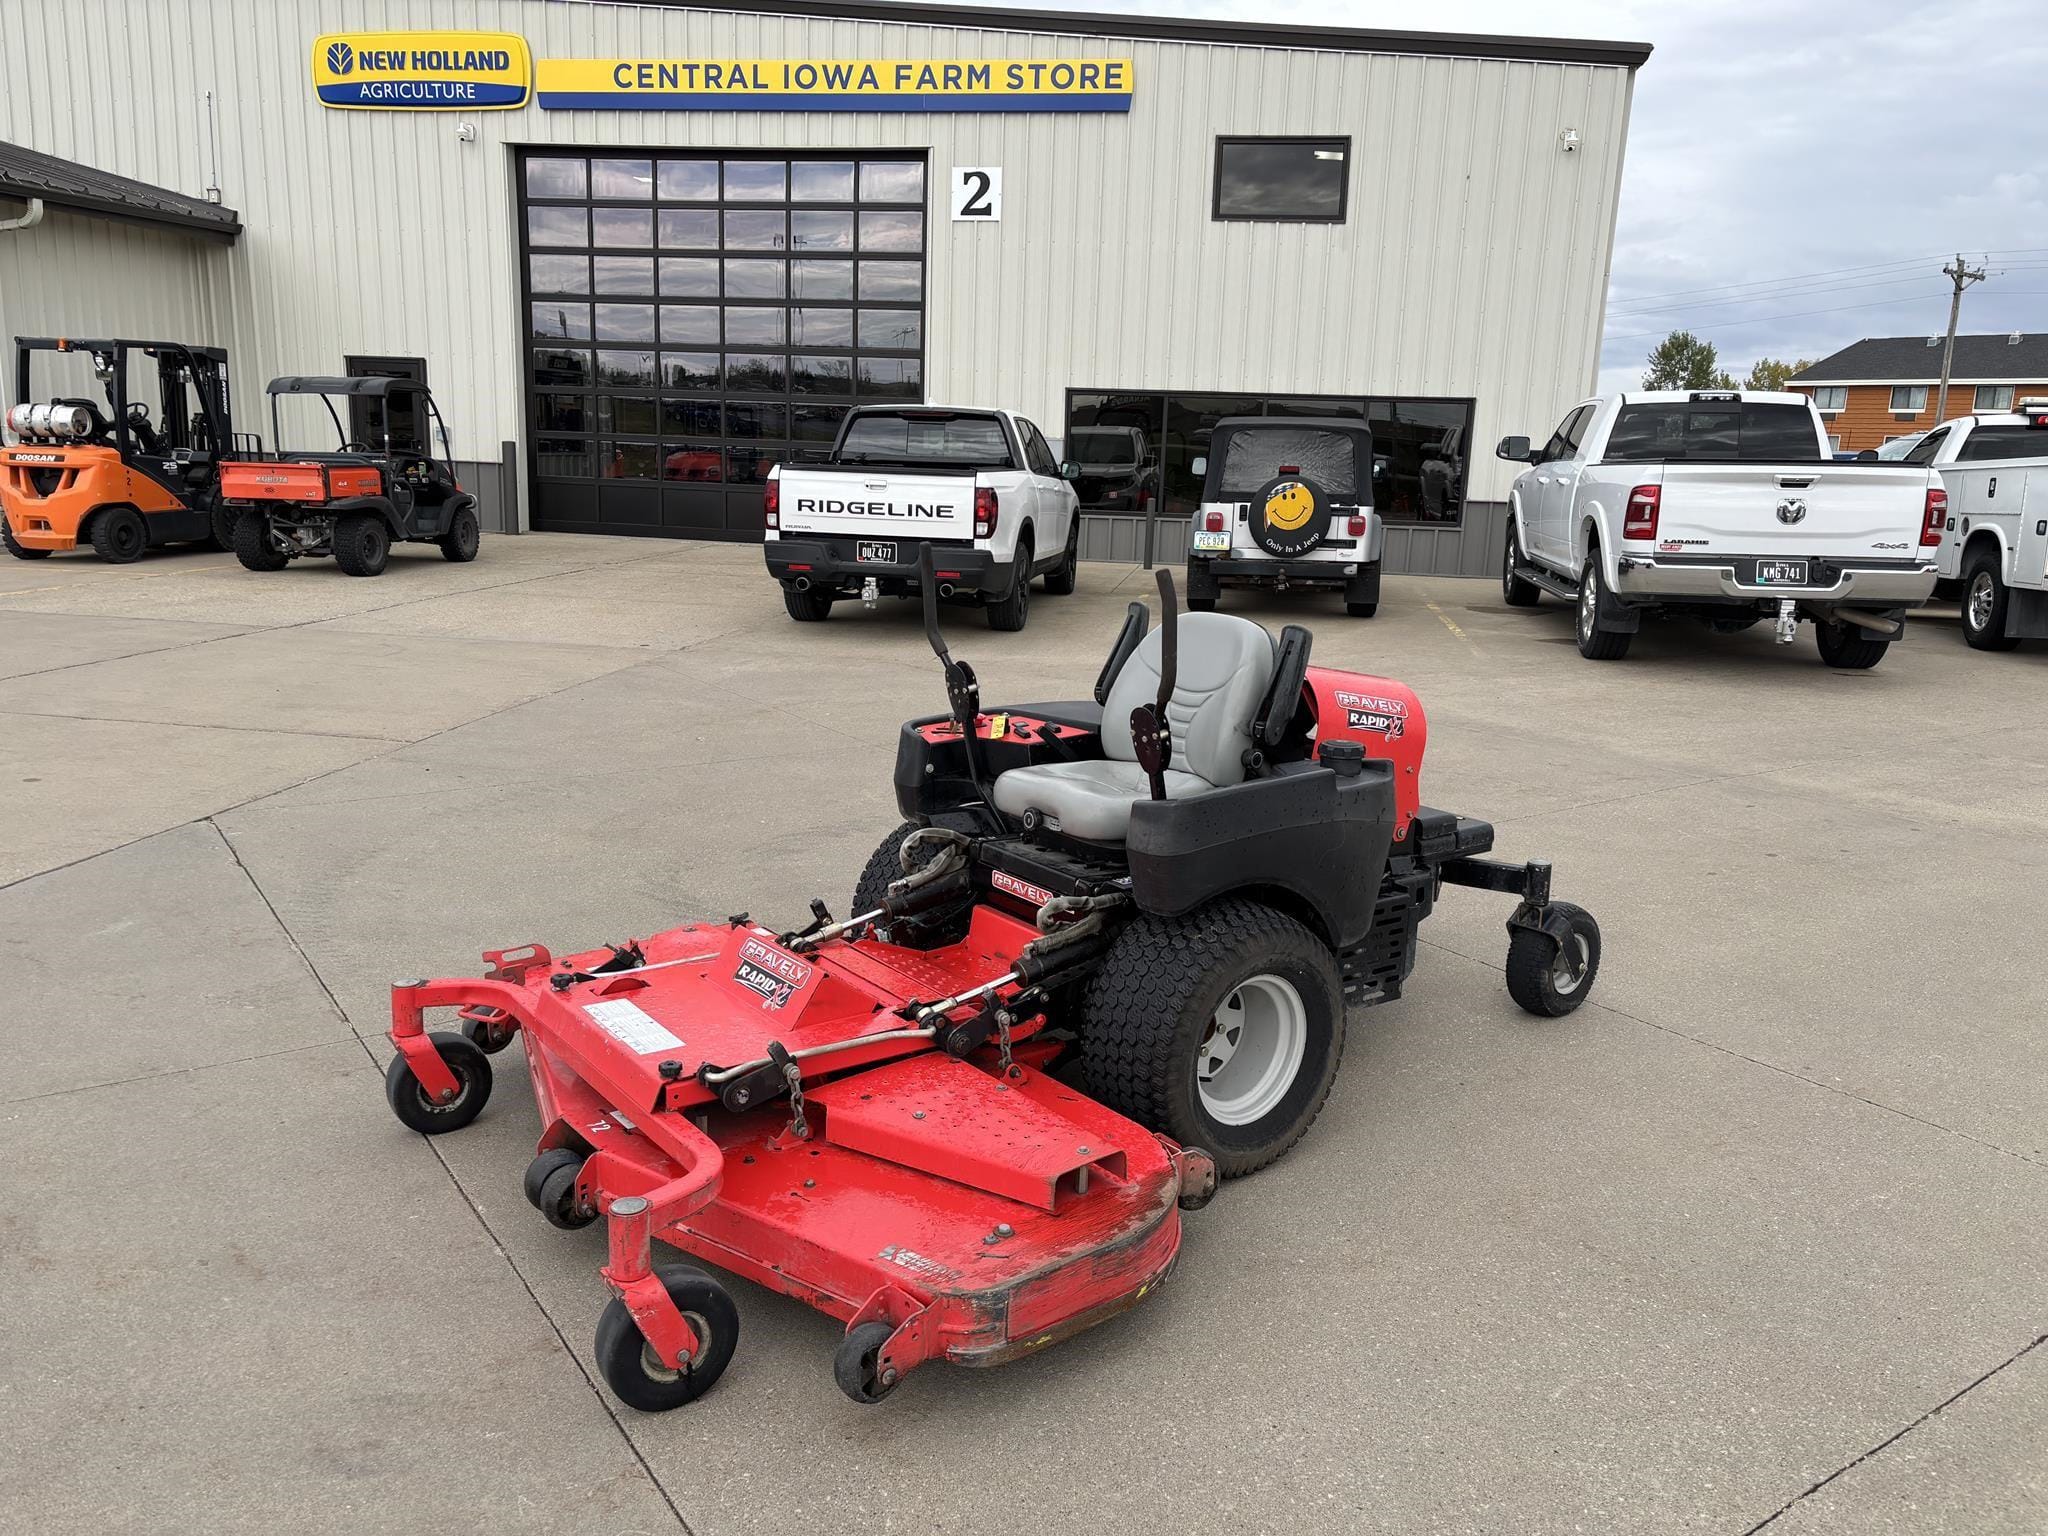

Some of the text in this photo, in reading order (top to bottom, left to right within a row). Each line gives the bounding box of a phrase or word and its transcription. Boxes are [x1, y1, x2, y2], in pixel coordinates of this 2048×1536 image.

[359, 50, 510, 71] NEW HOLLAND
[613, 63, 1123, 91] CENTRAL IOWA FARM STORE
[360, 83, 476, 99] AGRICULTURE
[960, 171, 992, 217] 2
[15, 454, 56, 462] DOOSAN
[162, 461, 178, 470] 25
[797, 498, 954, 519] RIDGELINE
[1198, 537, 1225, 546] PEC 920
[1265, 538, 1284, 553] Only
[1303, 532, 1320, 549] Jeep
[878, 547, 891, 558] 477
[1763, 567, 1801, 579] KMG 741
[1337, 693, 1404, 714] GRAVELY
[1350, 712, 1388, 728] RAPID
[993, 873, 1052, 904] GRAVELY
[743, 941, 808, 982] GRAVELY
[738, 964, 776, 991] RAPID
[586, 1119, 612, 1133] 72
